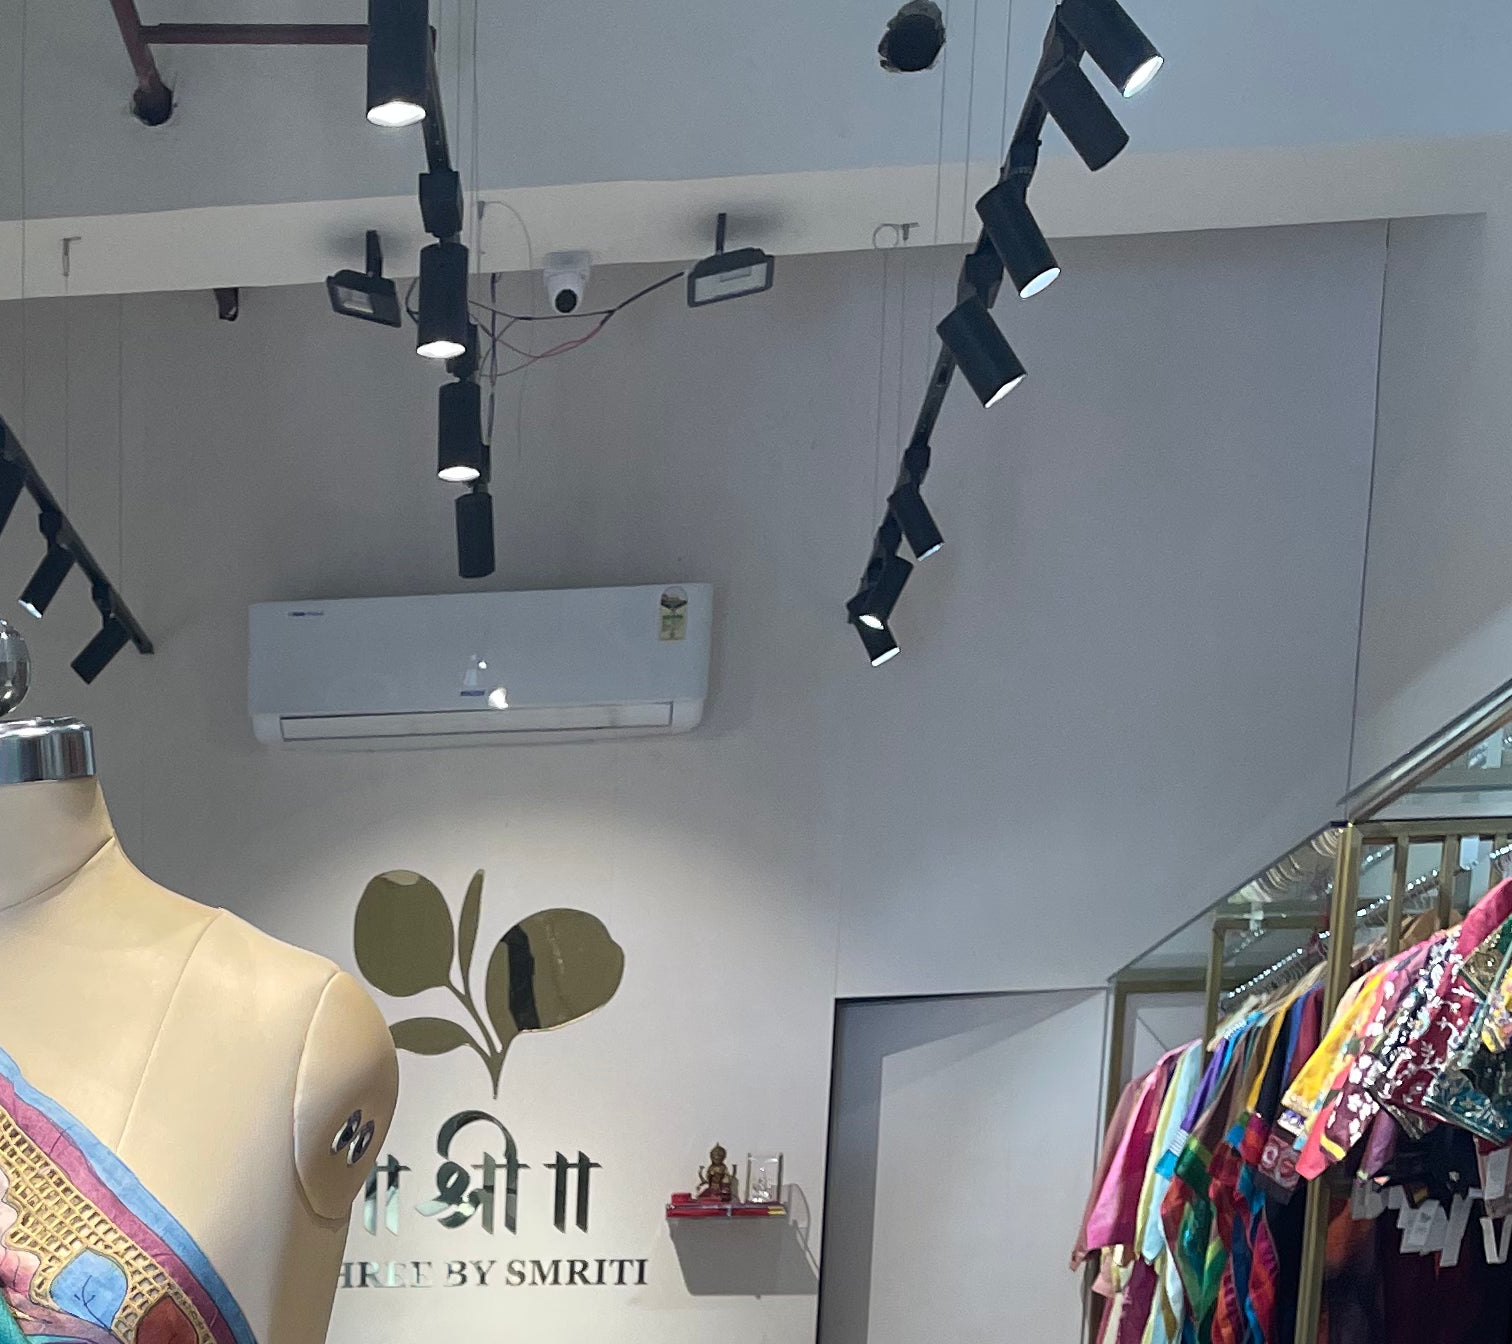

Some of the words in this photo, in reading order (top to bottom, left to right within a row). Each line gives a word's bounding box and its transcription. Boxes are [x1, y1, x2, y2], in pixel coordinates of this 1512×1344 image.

[338, 1260, 433, 1289] HREE
[443, 1259, 498, 1288] BY
[504, 1257, 649, 1287] SMRITI
